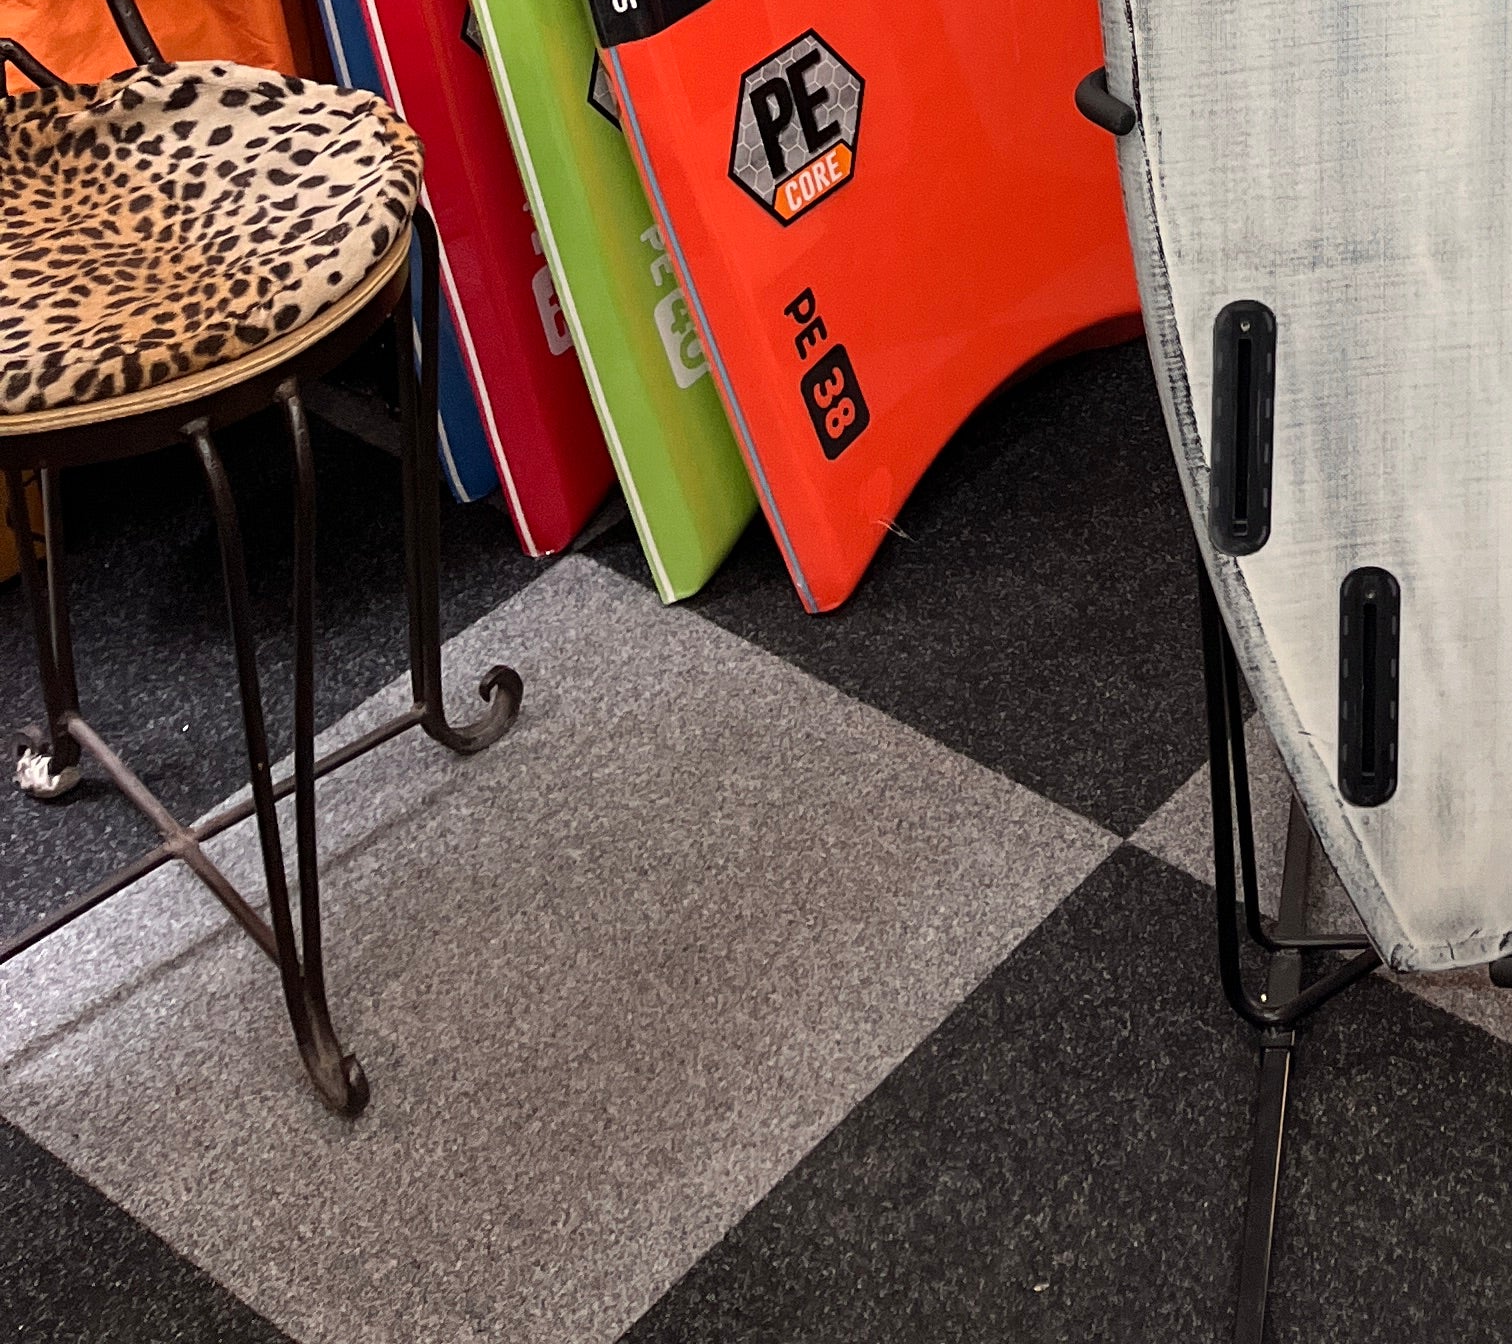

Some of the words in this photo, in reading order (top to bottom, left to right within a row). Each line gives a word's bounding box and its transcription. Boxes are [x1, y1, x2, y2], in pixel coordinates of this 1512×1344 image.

[748, 47, 842, 180] PE
[784, 149, 844, 213] CORE
[783, 286, 828, 361] PE
[812, 365, 857, 440] 38
